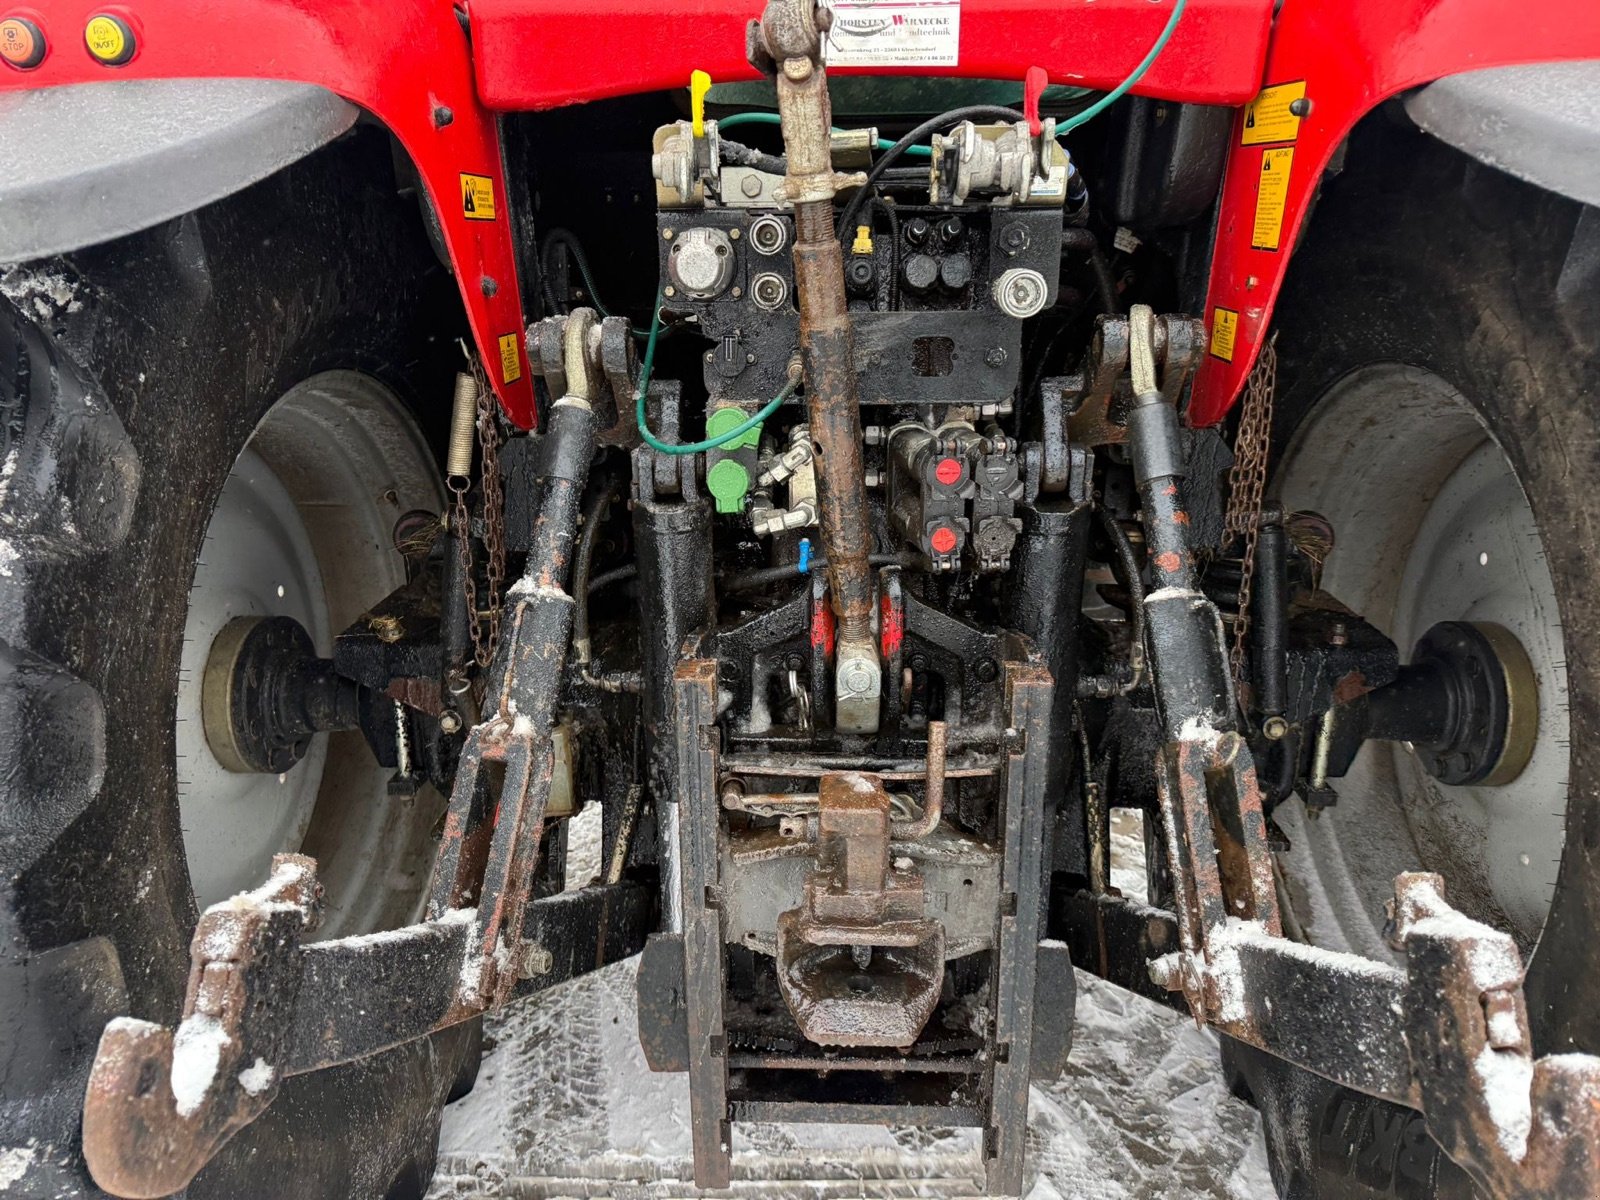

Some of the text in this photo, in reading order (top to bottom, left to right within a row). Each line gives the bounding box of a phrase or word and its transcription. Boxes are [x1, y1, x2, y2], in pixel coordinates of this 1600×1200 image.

[835, 16, 887, 27] HORSTEN
[2, 43, 25, 51] STOP
[93, 40, 115, 49] ON/OFF
